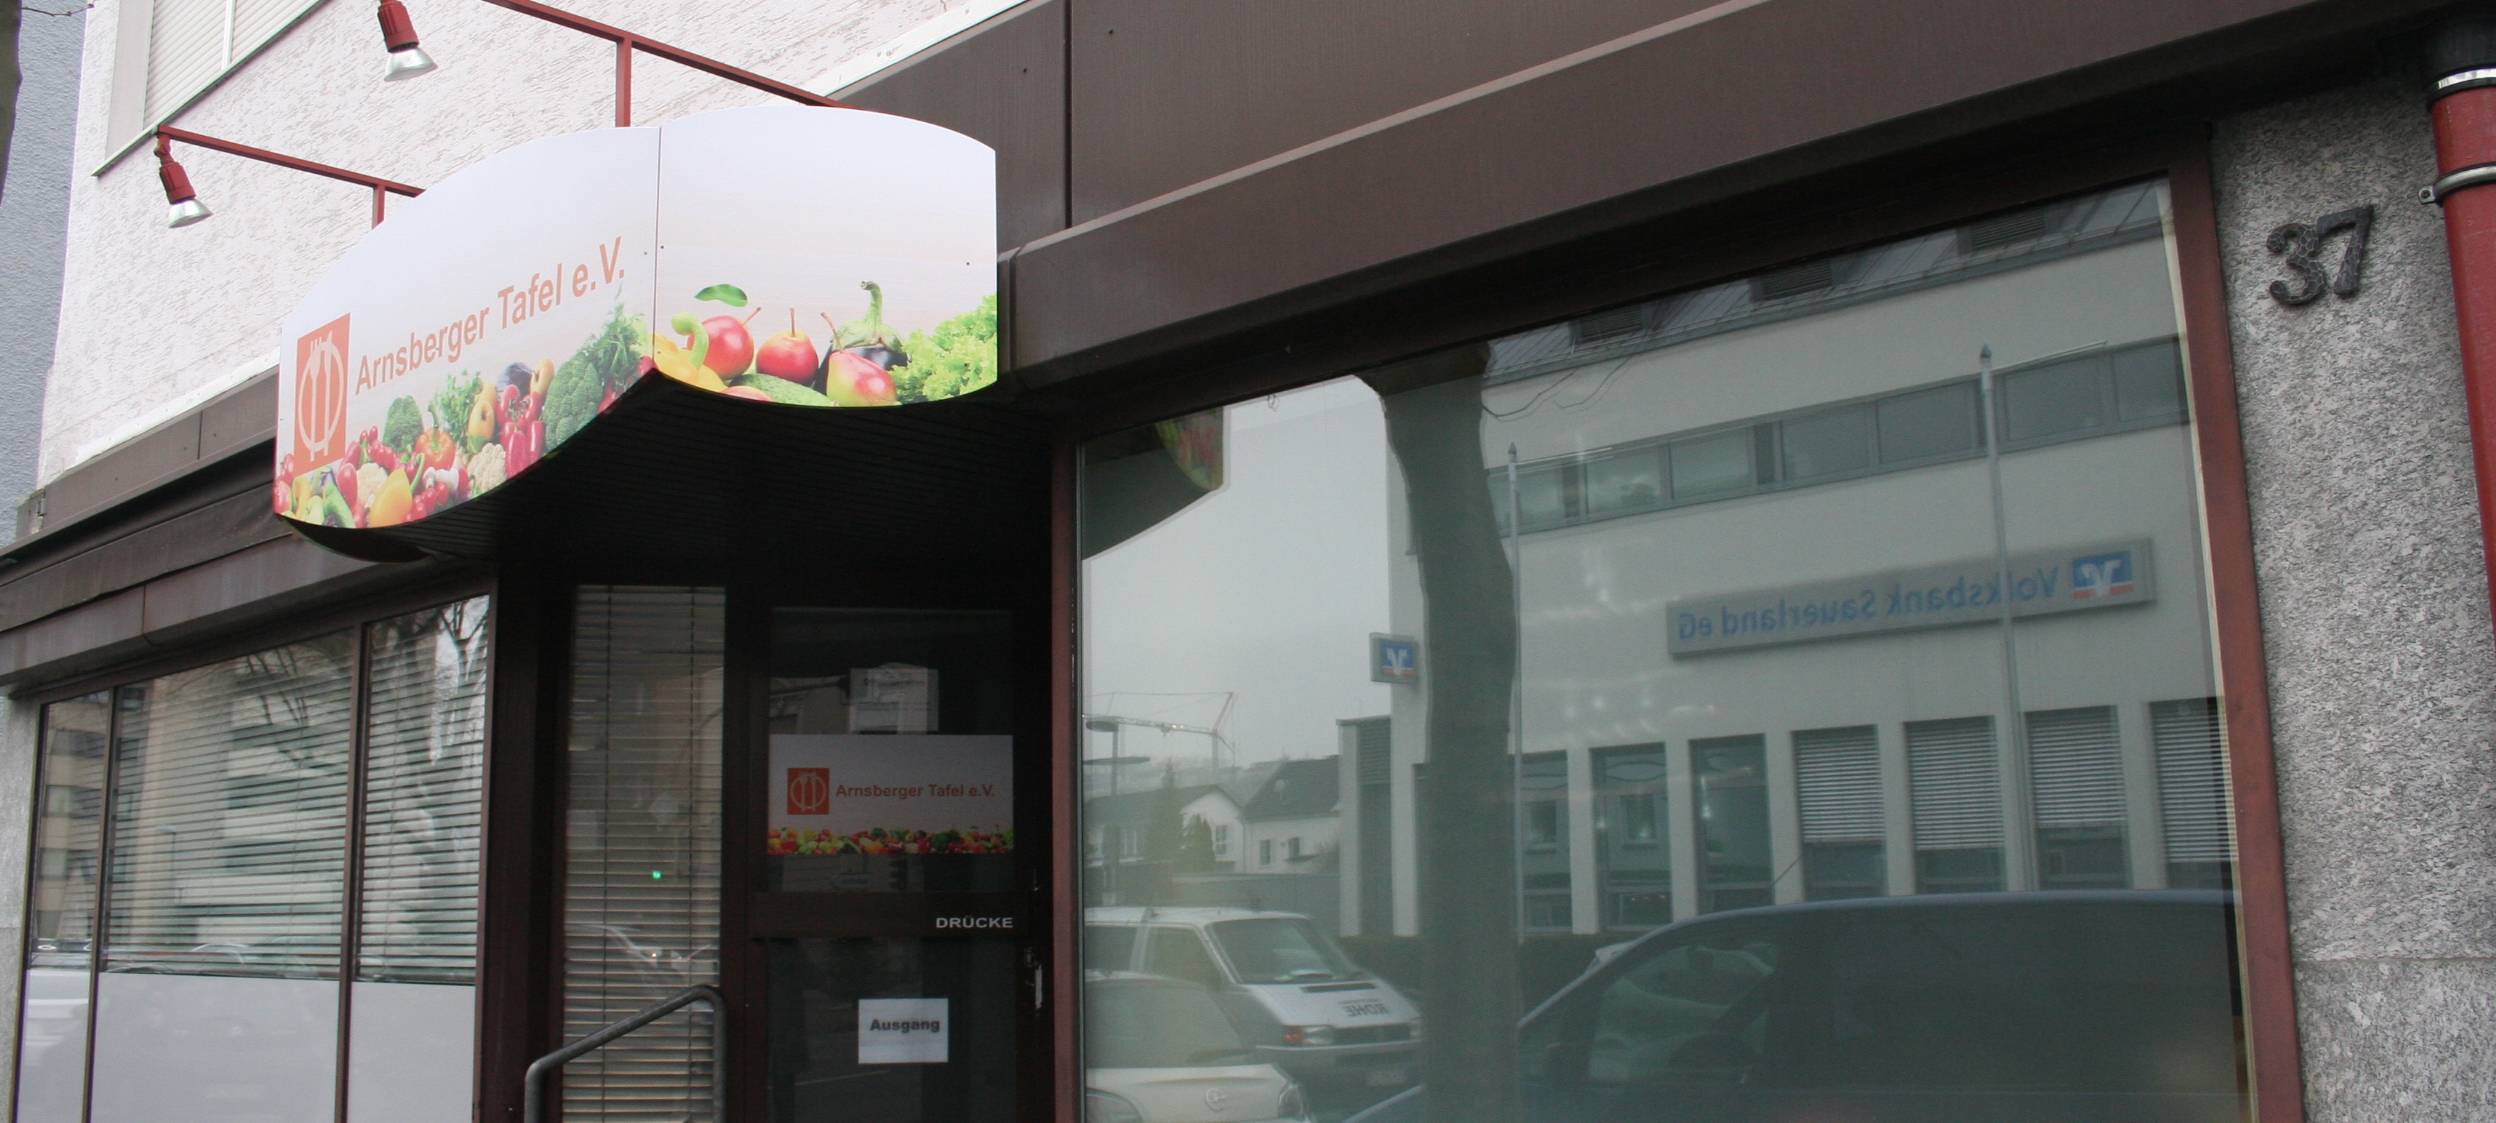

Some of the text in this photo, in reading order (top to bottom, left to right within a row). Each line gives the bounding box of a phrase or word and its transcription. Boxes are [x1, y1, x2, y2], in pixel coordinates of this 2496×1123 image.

[2266, 202, 2374, 305] 37
[355, 236, 624, 395] Arnsberger Tafel e.V.
[836, 784, 995, 800] Arnsberger Tafel e.V.
[935, 915, 1014, 928] DRÜCKE
[870, 1018, 940, 1034] Ausgang
